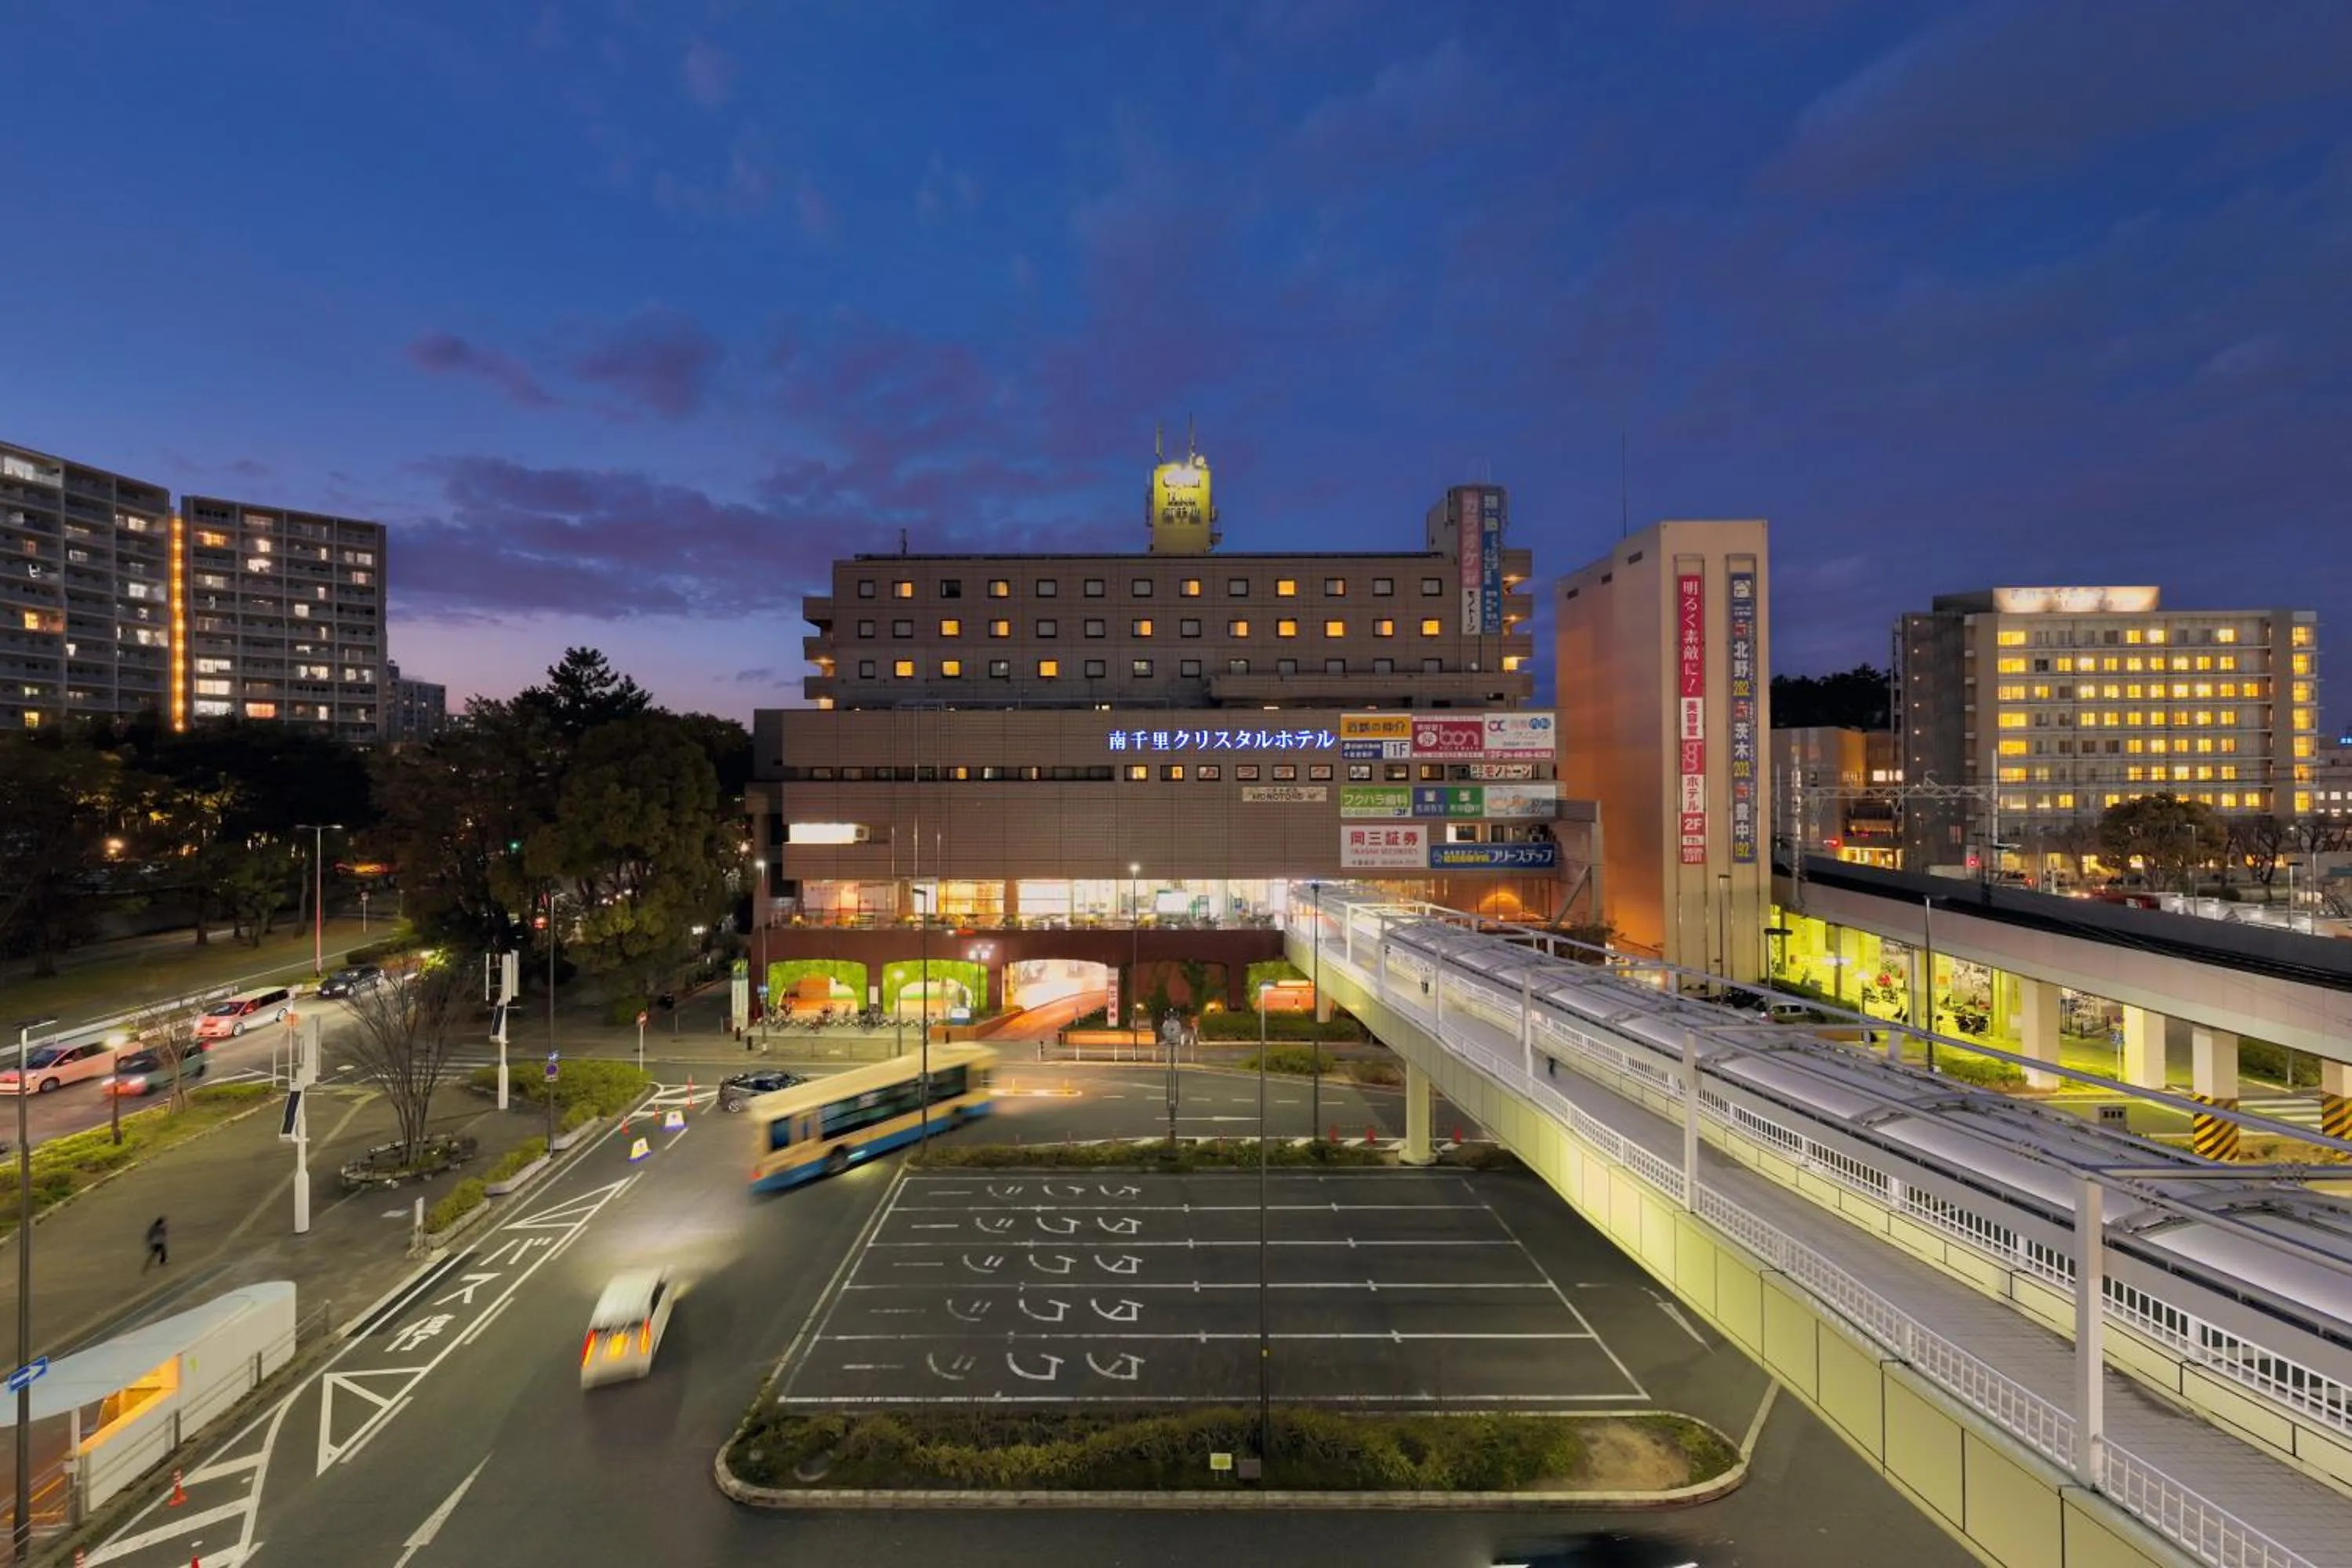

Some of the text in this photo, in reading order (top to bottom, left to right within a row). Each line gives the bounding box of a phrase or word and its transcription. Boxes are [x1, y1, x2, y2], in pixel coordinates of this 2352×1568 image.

[1734, 641, 1748, 677] 北野
[1108, 730, 1335, 751] 南千里クリスタルホテル
[1687, 775, 1699, 811] ホテル
[1684, 818, 1703, 831] 2F
[1350, 831, 1418, 846] 岡三証券
